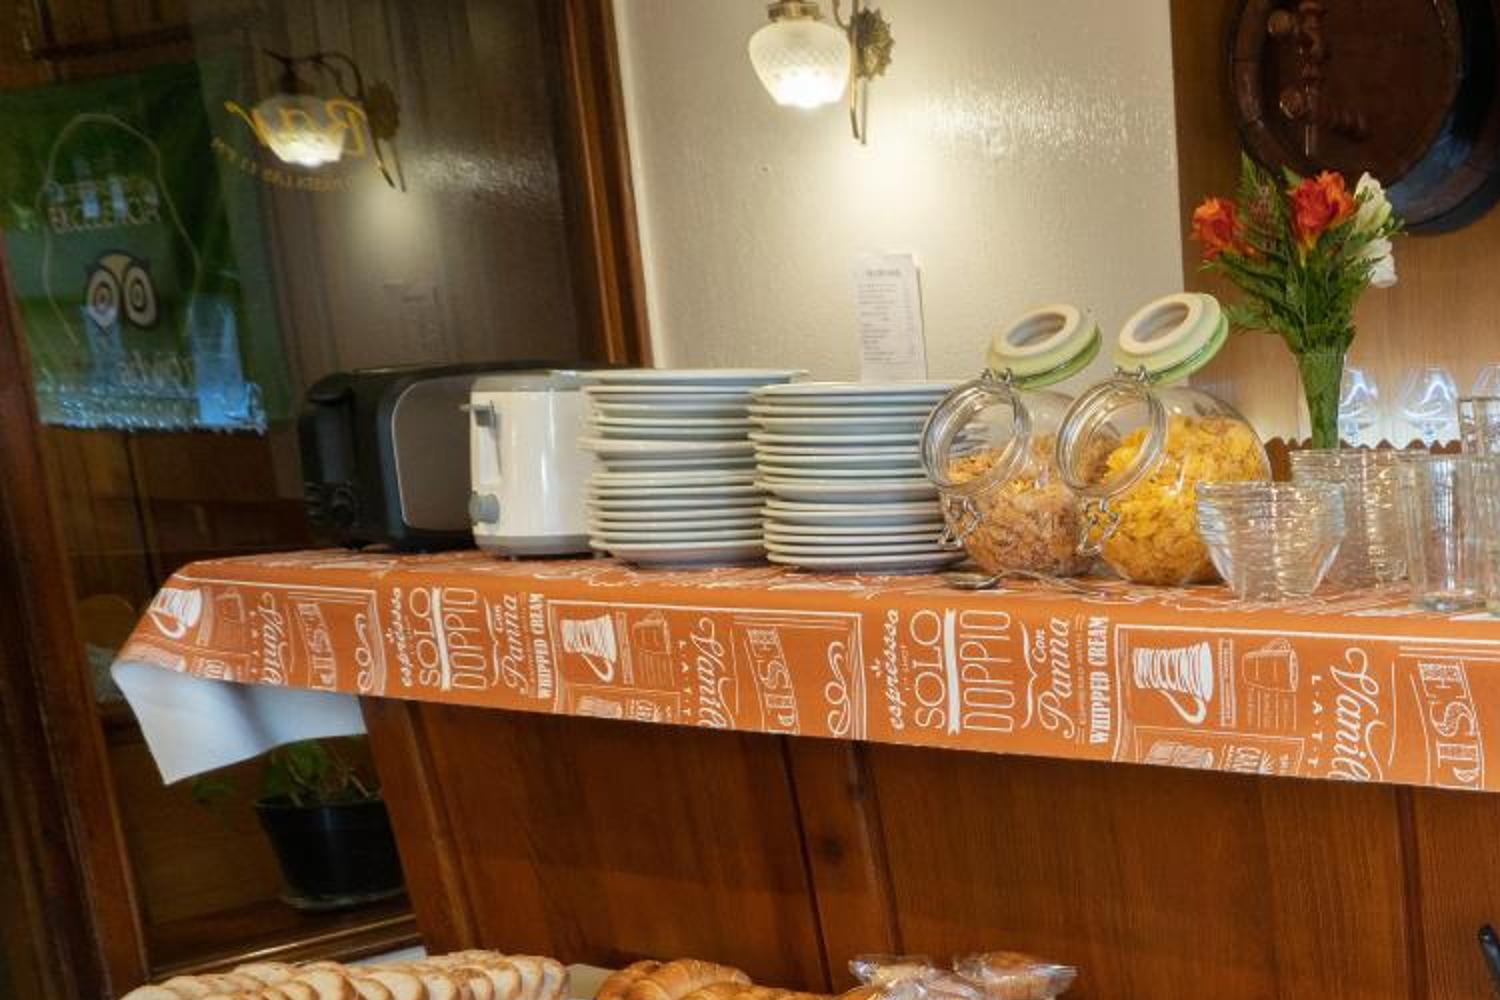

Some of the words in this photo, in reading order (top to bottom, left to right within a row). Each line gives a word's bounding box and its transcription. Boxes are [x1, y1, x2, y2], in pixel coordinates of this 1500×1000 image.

[409, 587, 440, 686] SOLO
[442, 587, 487, 690] DOPPIO
[501, 594, 528, 695] Panna
[528, 592, 545, 636] CREAM
[1031, 628, 1047, 663] Con
[1087, 616, 1109, 666] CREAM
[910, 609, 945, 729] SOLO
[959, 609, 1015, 732] DOPPIO
[1037, 617, 1076, 740] Panna
[1089, 671, 1111, 744] WHIPPED
